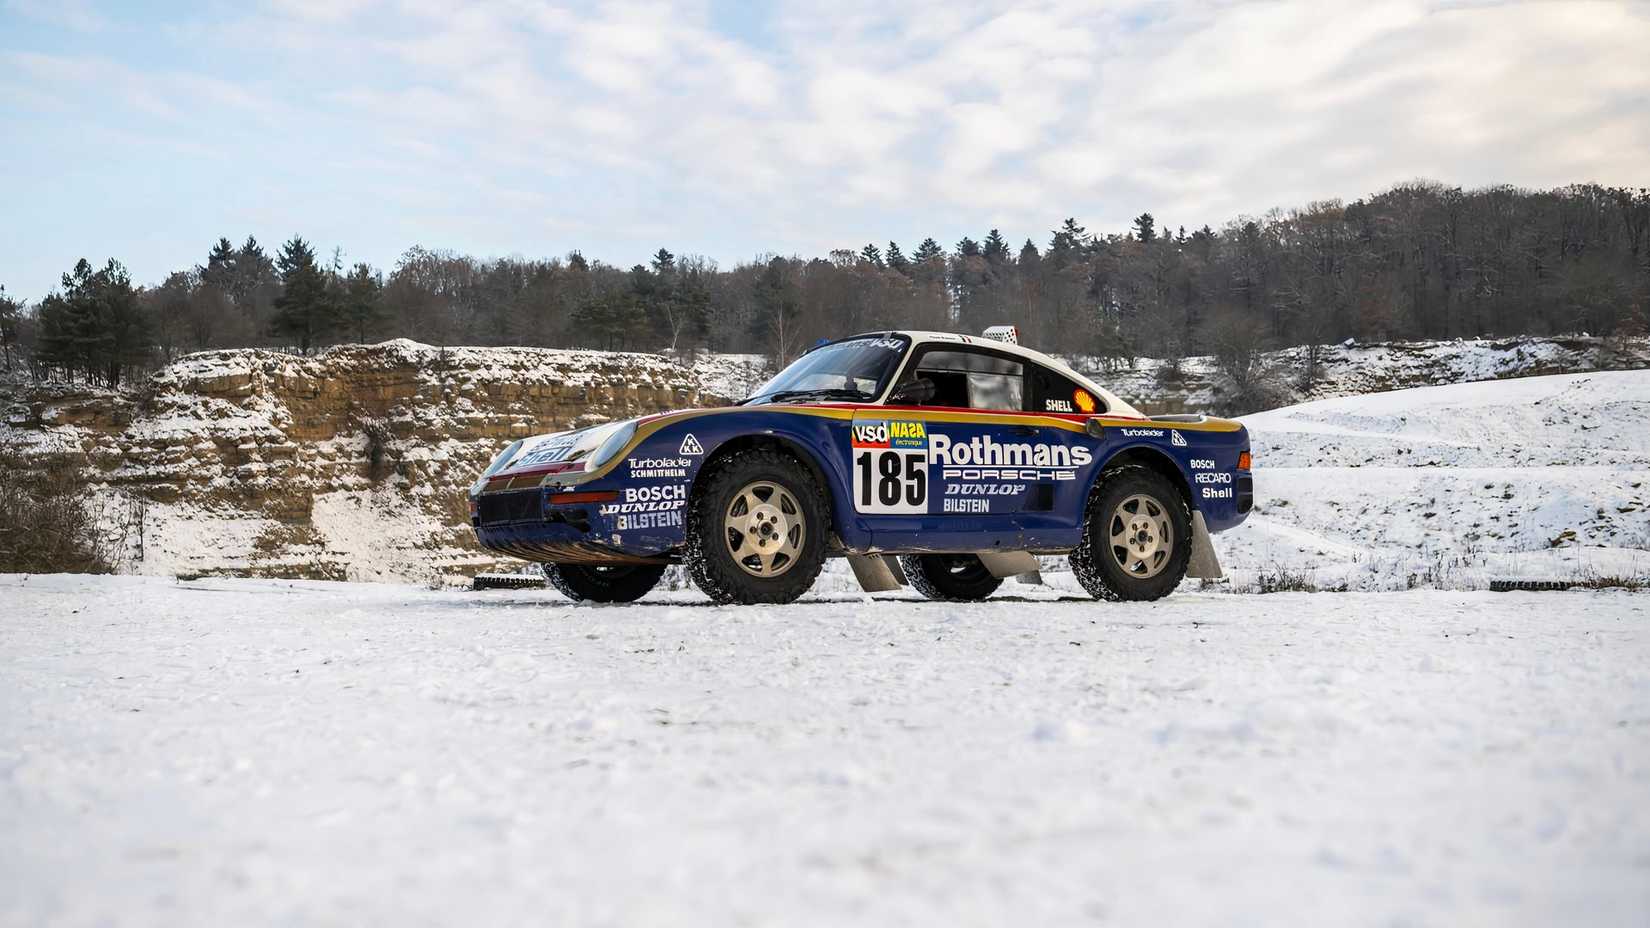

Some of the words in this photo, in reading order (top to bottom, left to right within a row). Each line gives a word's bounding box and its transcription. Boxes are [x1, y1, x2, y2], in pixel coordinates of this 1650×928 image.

[1045, 399, 1073, 412] SHELL
[855, 422, 889, 443] vsd
[928, 434, 1093, 466] Rothmans
[1190, 459, 1215, 469] BOSCH
[857, 451, 927, 506] 185
[943, 469, 1077, 481] PORSCHE
[1195, 472, 1232, 484] RECARO
[625, 484, 686, 503] BOSCH
[944, 483, 1026, 496] DUNLOP
[1202, 487, 1233, 499] Shell
[607, 500, 686, 514] DUNLOP
[943, 498, 990, 513] BILSTEIN
[617, 510, 683, 531] BILSTEIN
